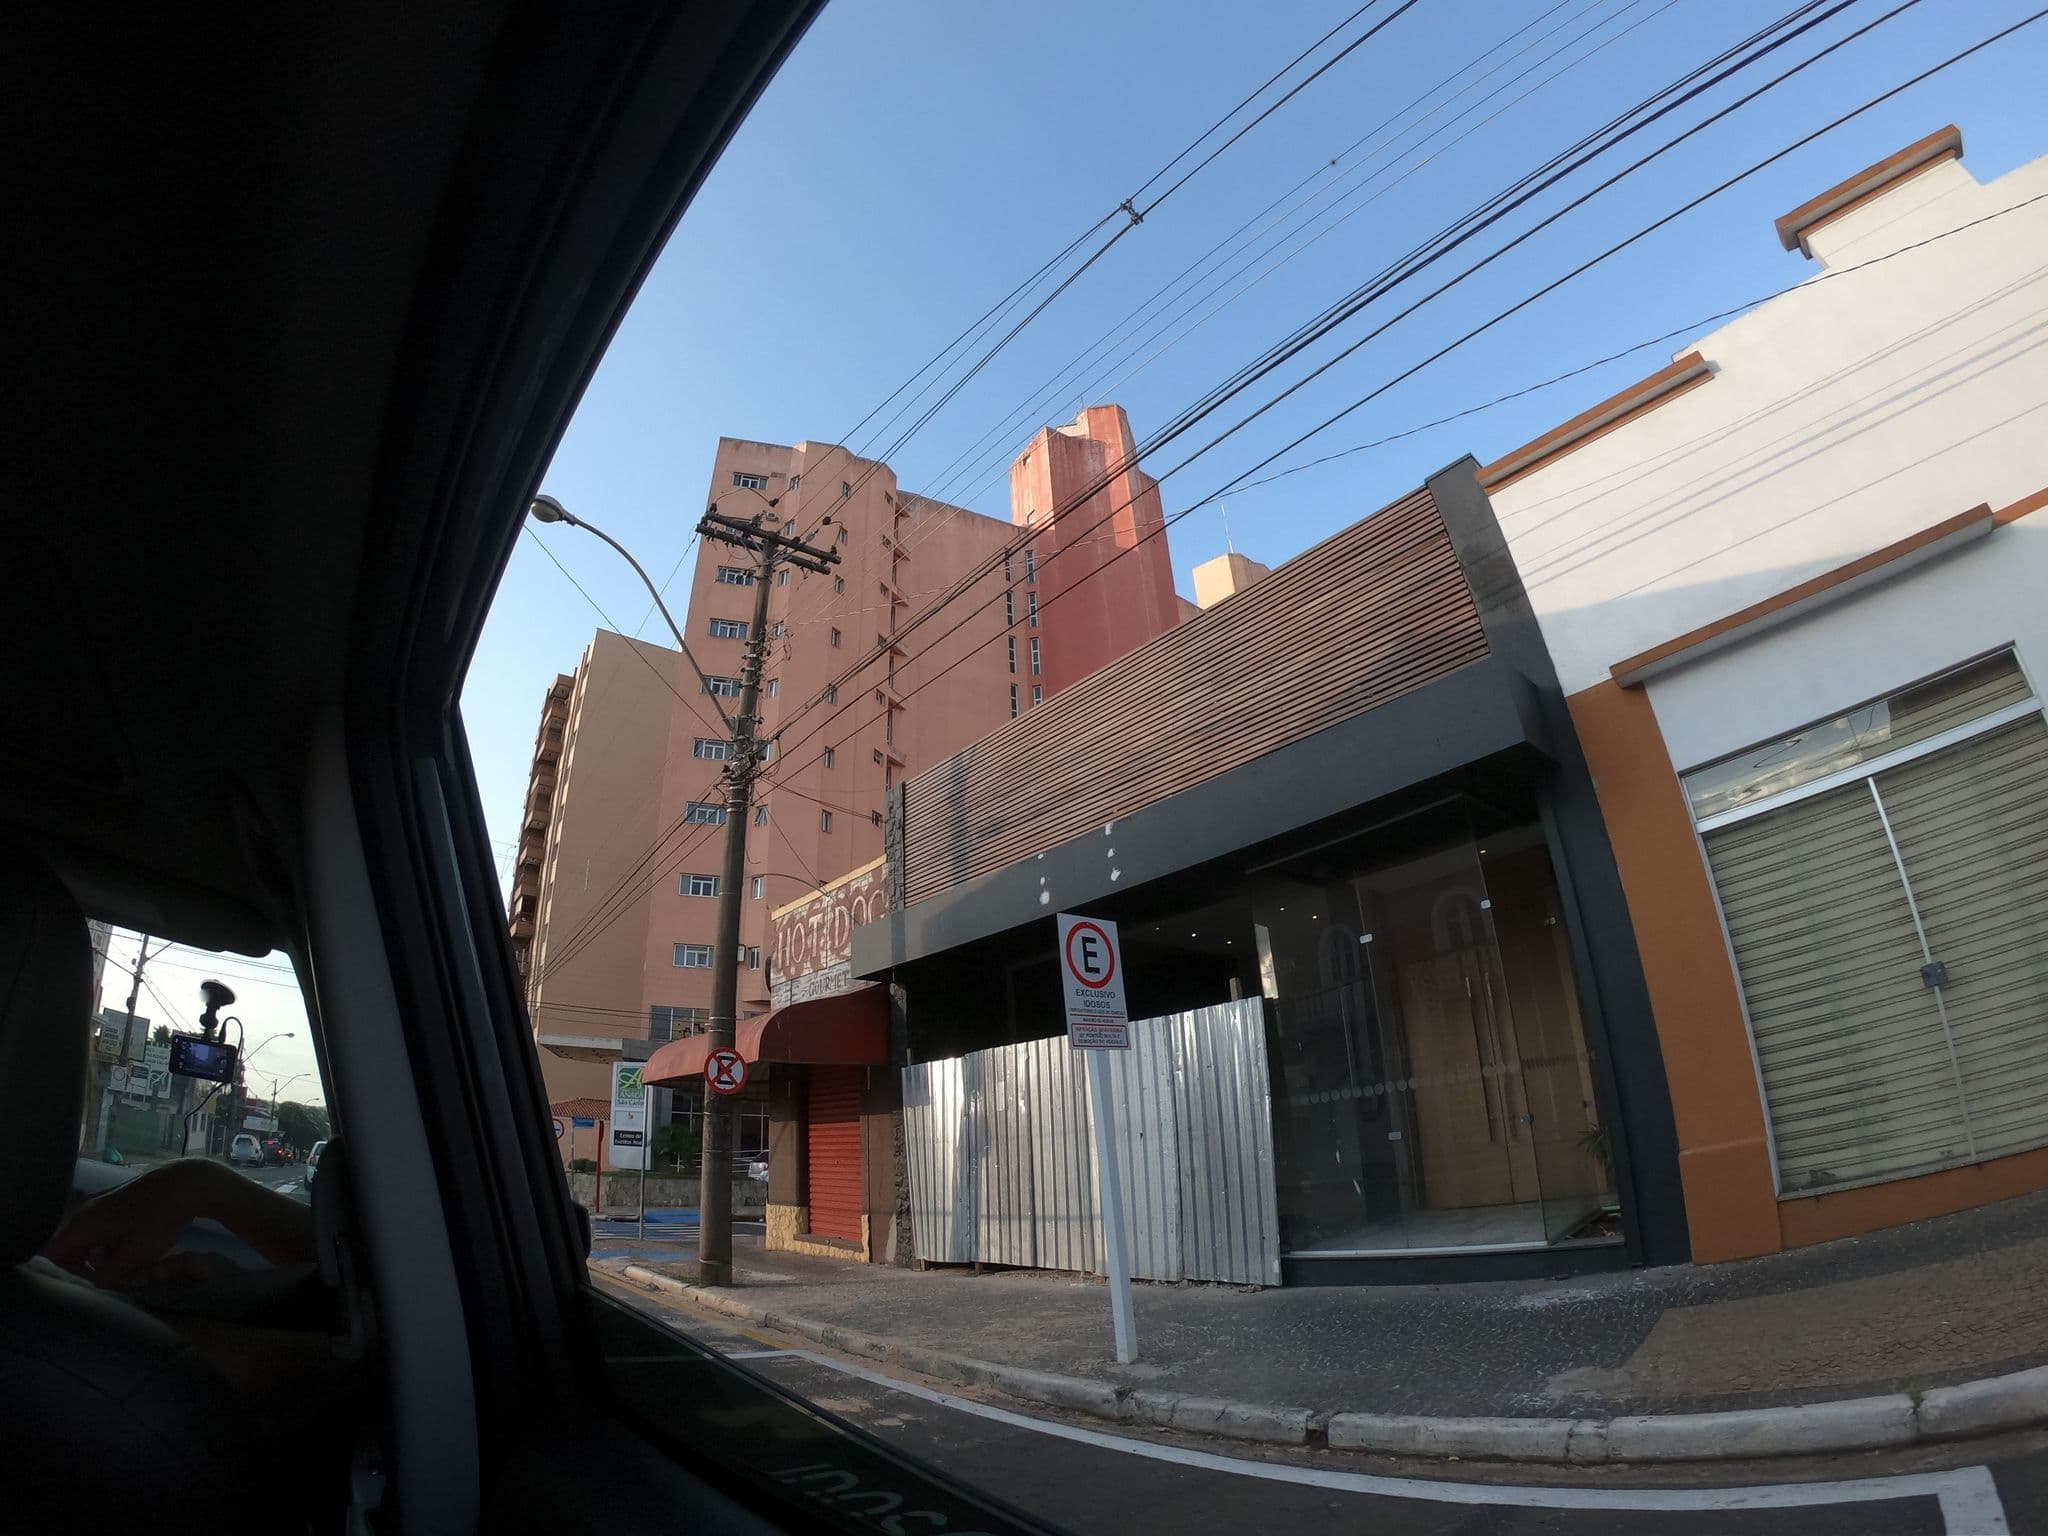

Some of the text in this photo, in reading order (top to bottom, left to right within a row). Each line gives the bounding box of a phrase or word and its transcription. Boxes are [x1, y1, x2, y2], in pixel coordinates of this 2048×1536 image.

[778, 913, 824, 969] HOT
[1081, 936, 1101, 974] E
[808, 969, 850, 997] GOURMET
[1075, 988, 1116, 999] EXCLUSIVO
[1083, 1000, 1111, 1009] IDOSOS
